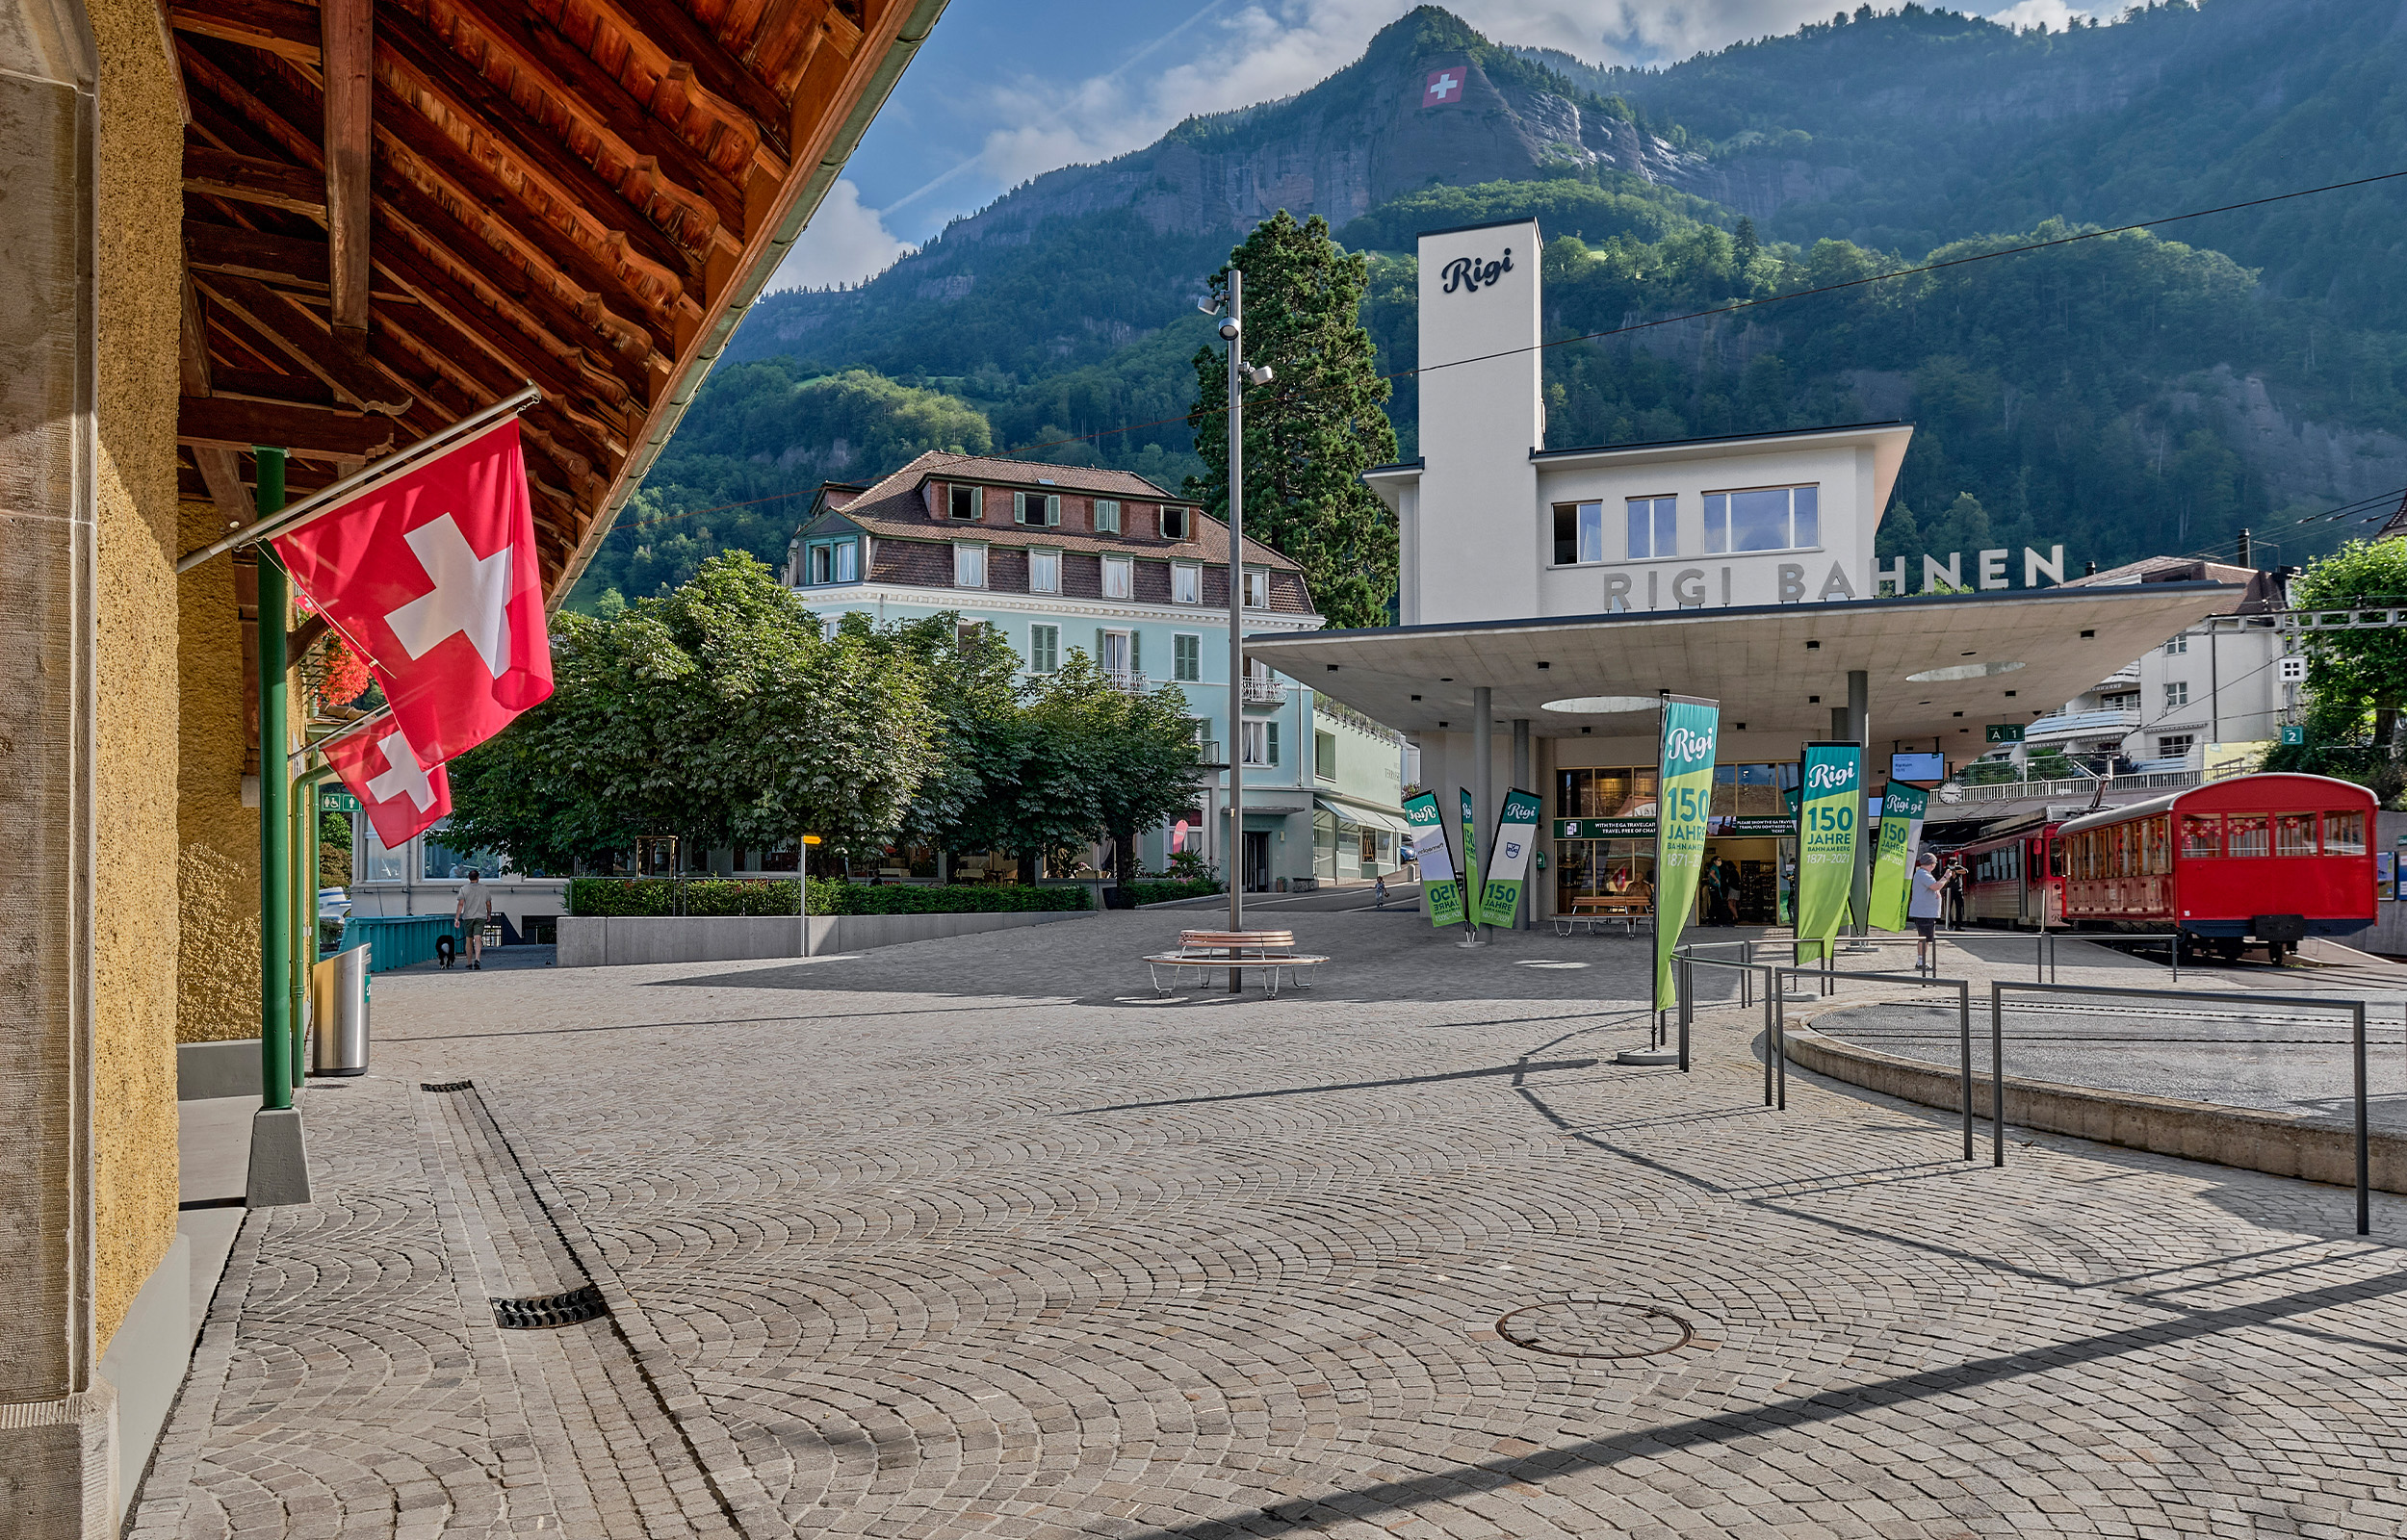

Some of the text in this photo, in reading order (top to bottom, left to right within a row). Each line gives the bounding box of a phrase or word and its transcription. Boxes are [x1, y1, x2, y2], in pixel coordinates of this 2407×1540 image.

[1441, 247, 1514, 294] Rigi
[1603, 544, 2064, 610] RIGI BAHNEN
[1991, 730, 2001, 740] A
[2011, 730, 2017, 739] 1
[2288, 732, 2297, 742] 2
[1669, 727, 1714, 762] Rigi
[1808, 760, 1855, 789] Rigi
[1507, 802, 1537, 820] Rigi
[1668, 786, 1710, 823] 150
[1886, 793, 1910, 813] Rigi
[1909, 800, 1924, 815] gi
[1807, 806, 1853, 832] 150
[1667, 824, 1706, 842] JAHRE
[1807, 834, 1851, 844] JAHRE
[1883, 822, 1906, 844] 150
[1881, 839, 1904, 855] JAHRE
[1488, 883, 1516, 903] 150
[1485, 899, 1513, 911] JAHRE
